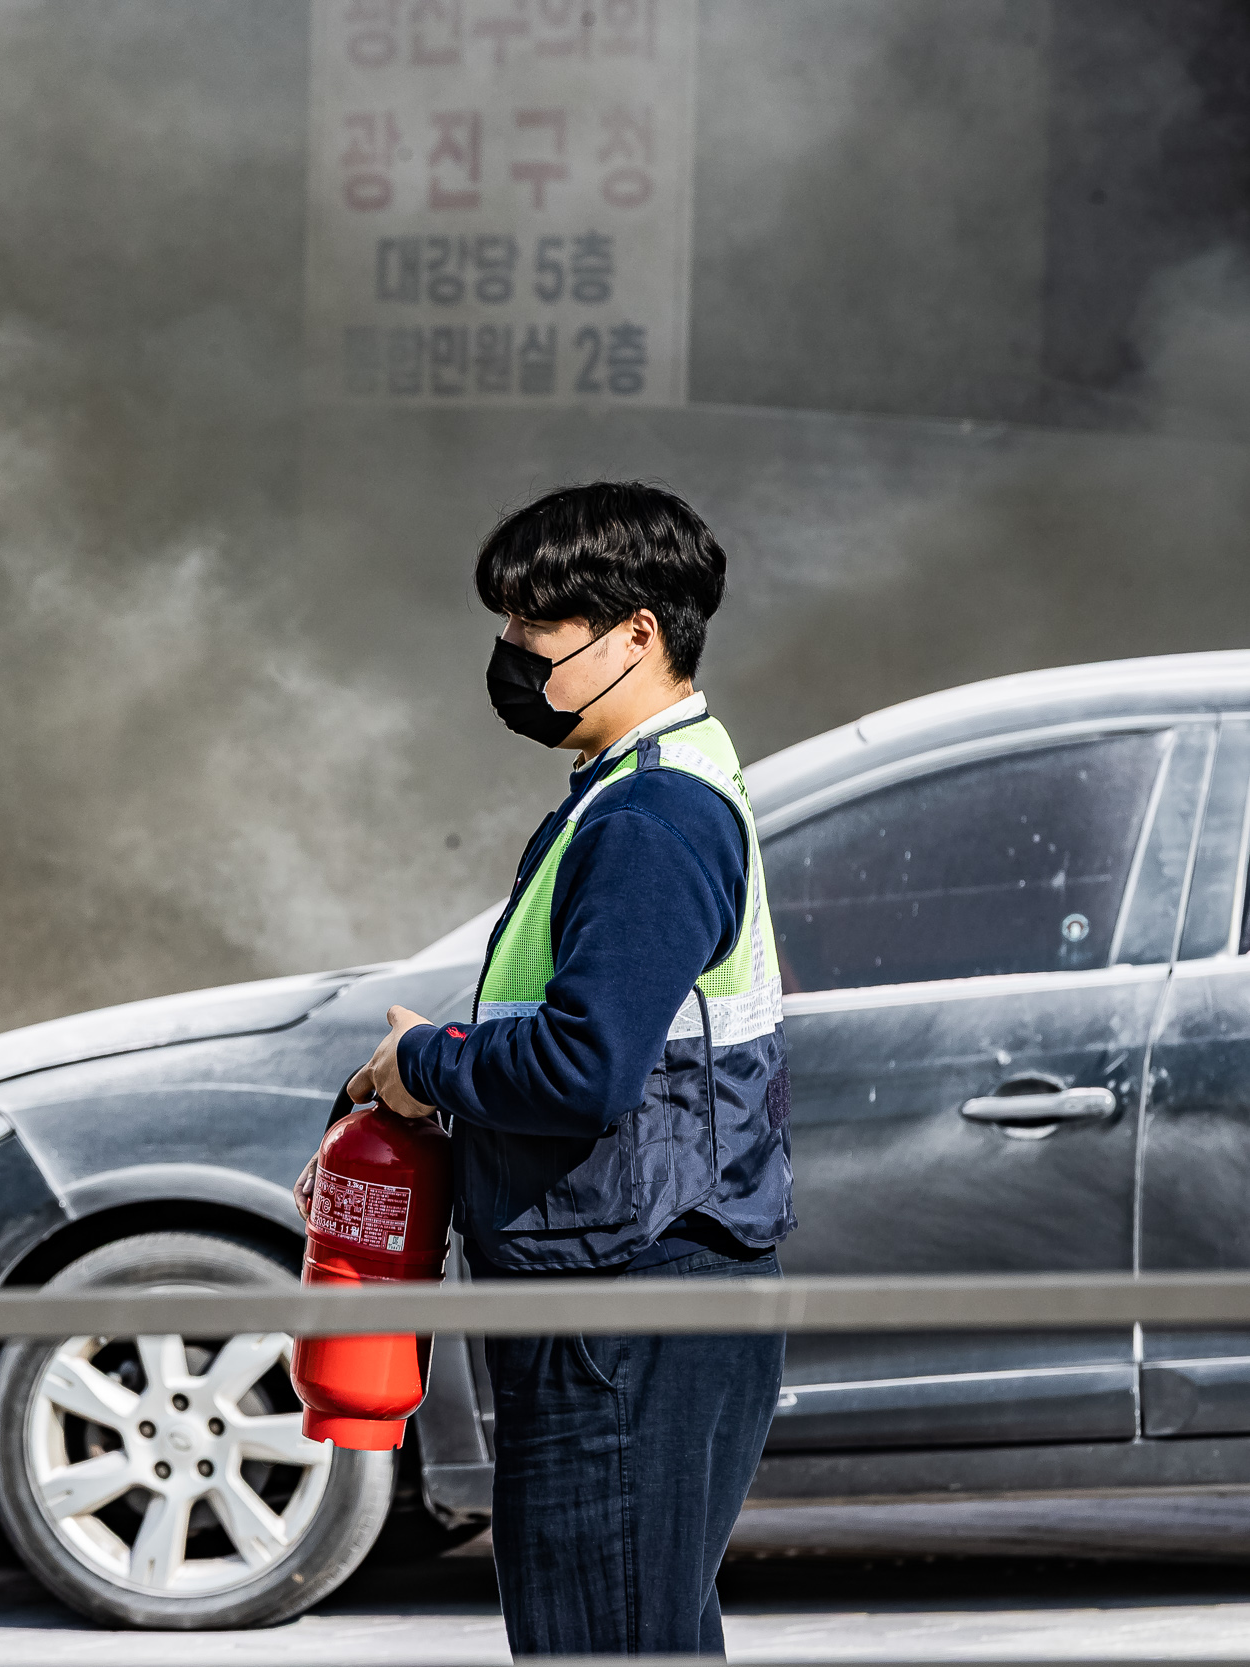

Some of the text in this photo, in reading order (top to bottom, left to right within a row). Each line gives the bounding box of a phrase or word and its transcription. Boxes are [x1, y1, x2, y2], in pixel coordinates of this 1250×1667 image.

[342, 107, 655, 212] 광진구청
[377, 229, 615, 306] 대강당 5층
[574, 319, 648, 397] 2층
